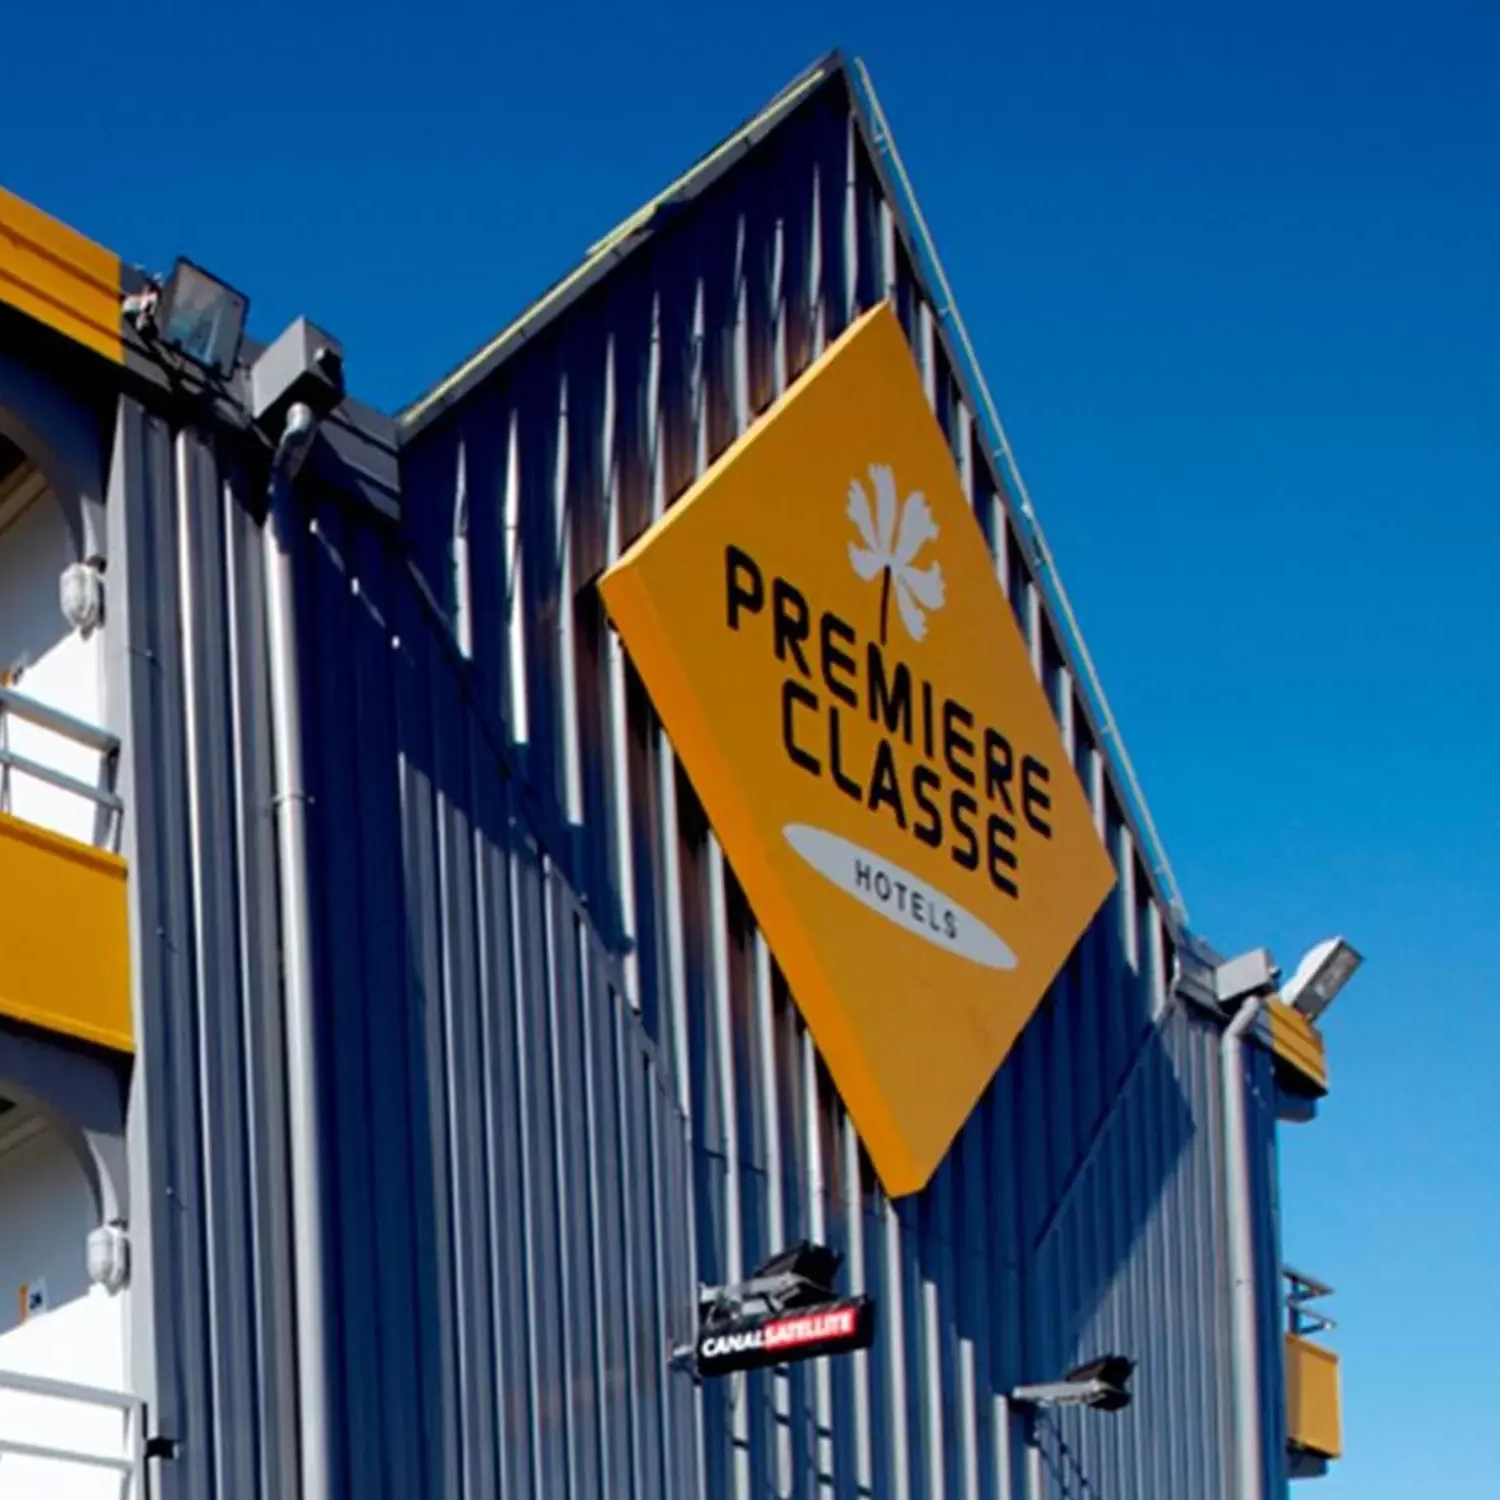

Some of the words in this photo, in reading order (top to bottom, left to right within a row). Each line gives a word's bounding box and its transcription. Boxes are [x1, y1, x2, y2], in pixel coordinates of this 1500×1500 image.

[725, 544, 1052, 840] PREMIERE
[781, 678, 1019, 900] CLASSE
[854, 860, 957, 940] HOTELS
